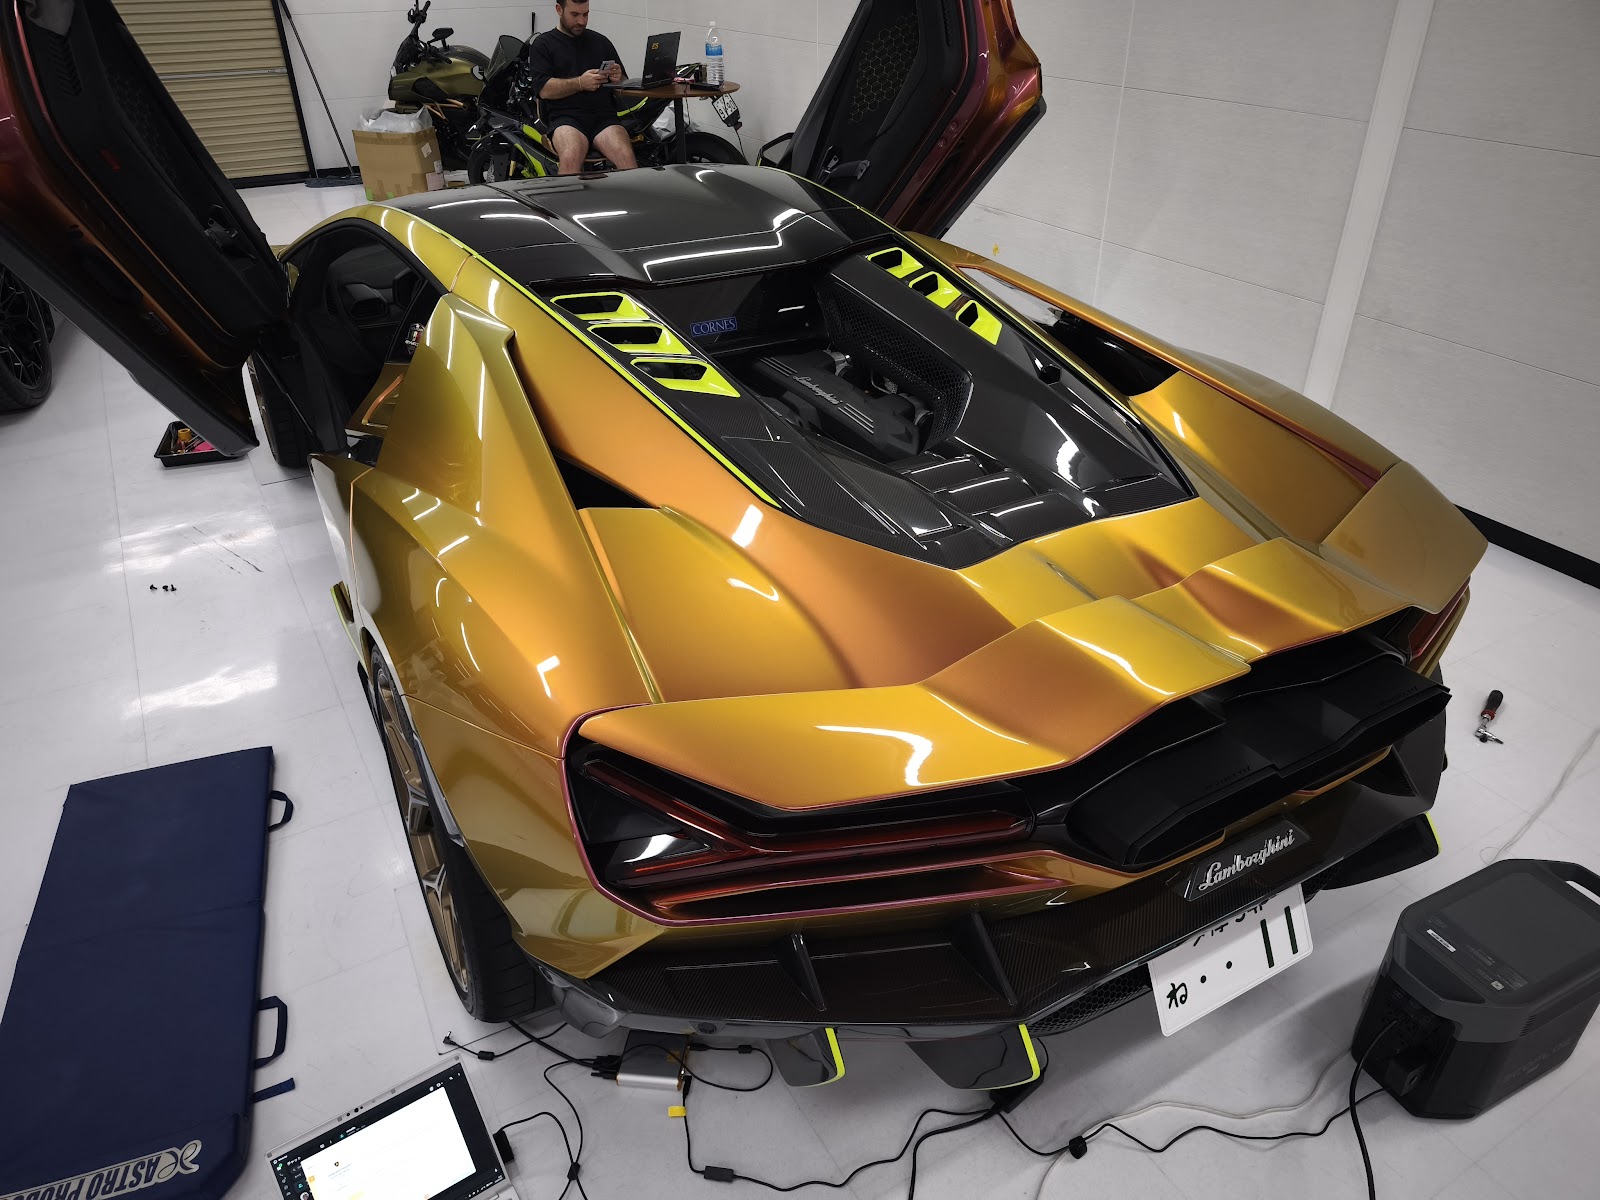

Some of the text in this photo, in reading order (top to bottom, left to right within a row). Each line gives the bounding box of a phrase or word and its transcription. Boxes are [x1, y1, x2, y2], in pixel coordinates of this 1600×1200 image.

[692, 319, 736, 335] CORNES
[1198, 828, 1295, 891] Lamborghini
[1166, 982, 1188, 1009] ね
[86, 1155, 161, 1200] ASTRO
